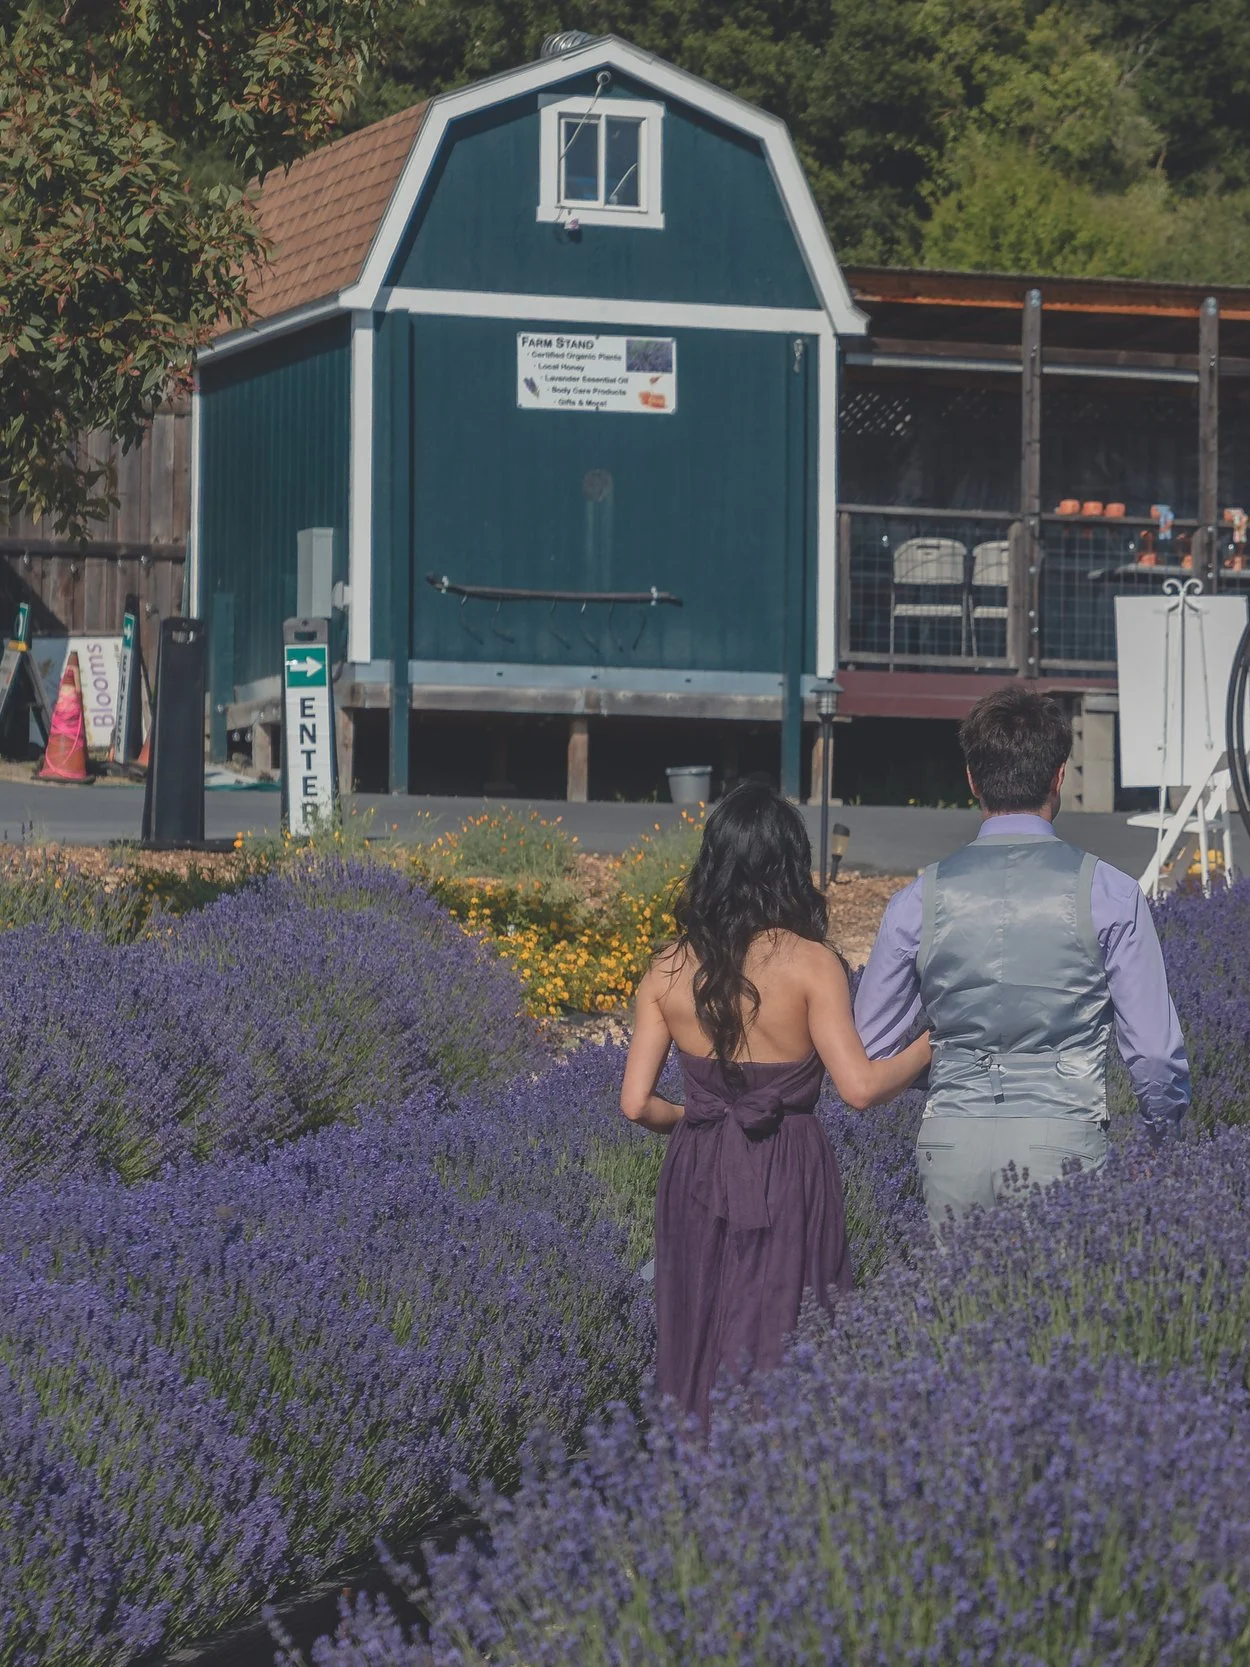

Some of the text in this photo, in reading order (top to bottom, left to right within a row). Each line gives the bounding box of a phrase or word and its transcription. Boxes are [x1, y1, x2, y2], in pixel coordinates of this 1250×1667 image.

[521, 336, 595, 350] FARM STAND
[531, 351, 622, 361] Certified Organic Plants
[538, 363, 585, 372] Local Honey
[544, 375, 629, 384] Lavender Essential Oil
[551, 386, 627, 397] Body Care Products
[558, 398, 576, 407] Gifts
[578, 399, 584, 407] &
[87, 643, 115, 728] Blooms
